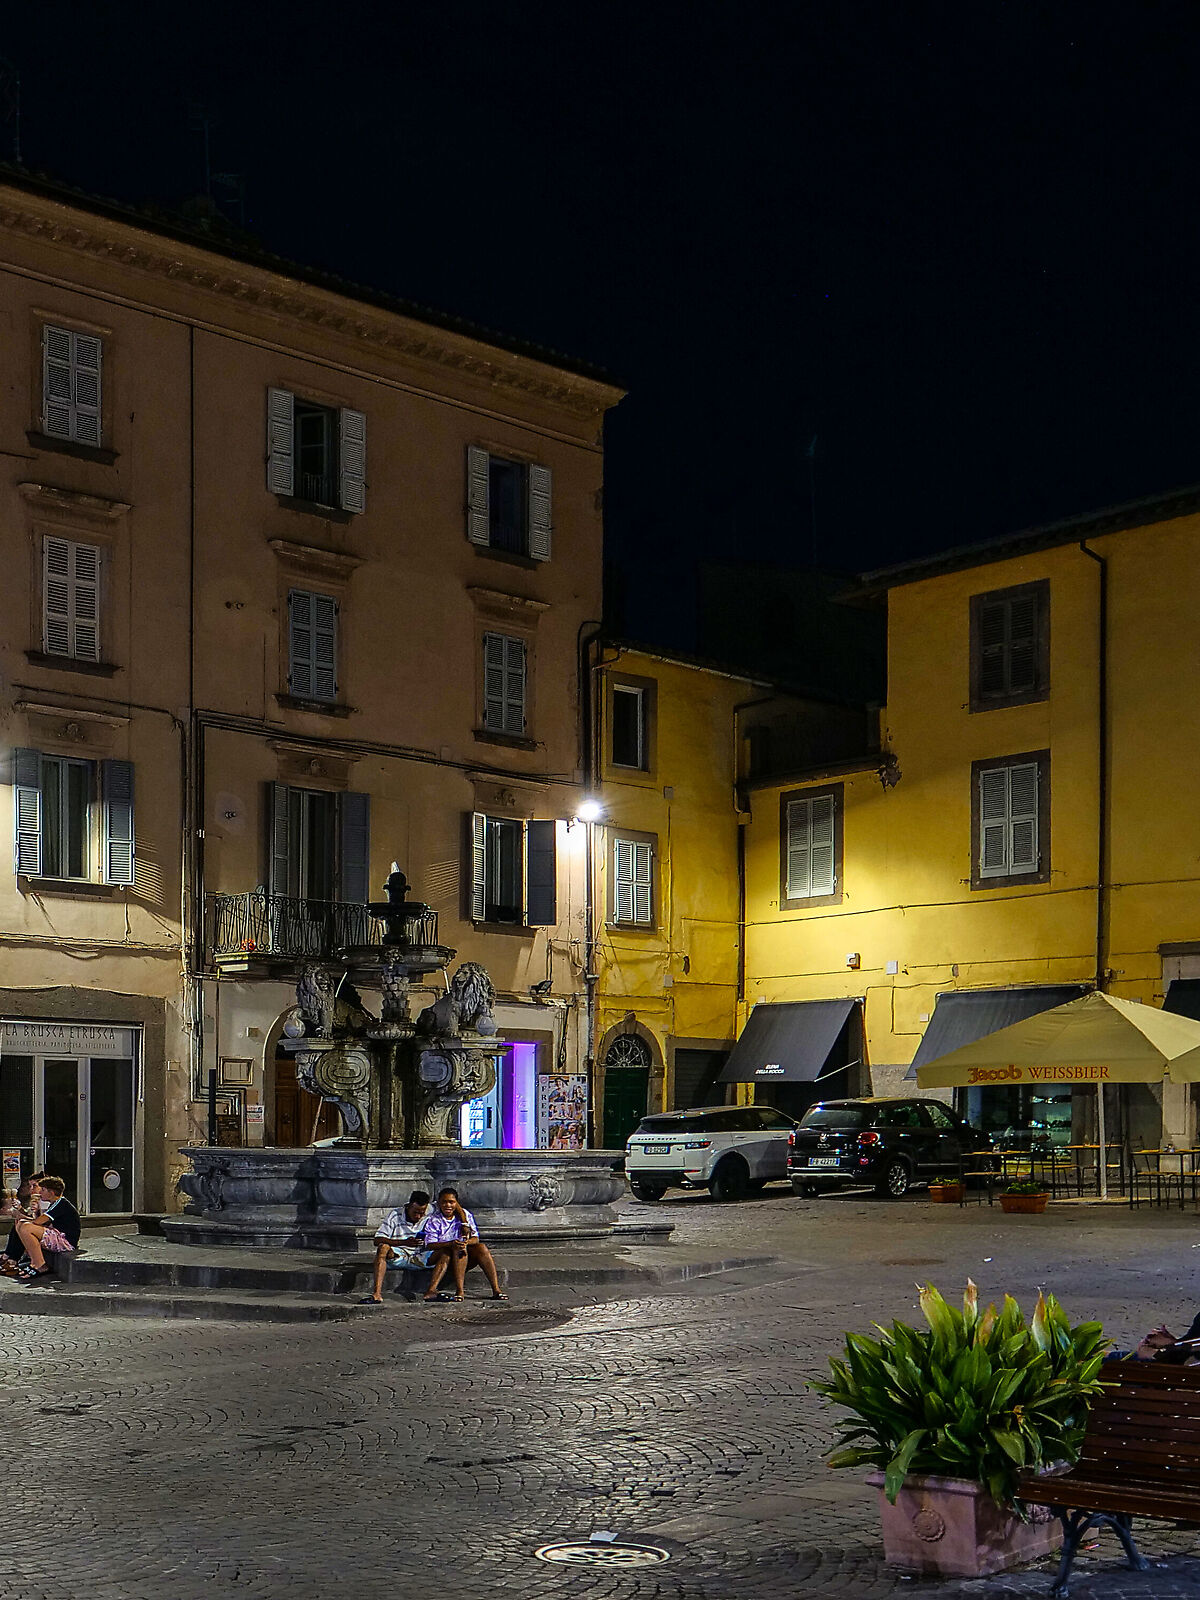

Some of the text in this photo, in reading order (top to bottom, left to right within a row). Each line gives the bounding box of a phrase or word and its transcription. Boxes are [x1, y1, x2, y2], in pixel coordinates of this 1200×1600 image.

[5, 1024, 115, 1040] LA BRUSCA ETRUSCA
[967, 1064, 1110, 1085] Jacob WEISSBIER
